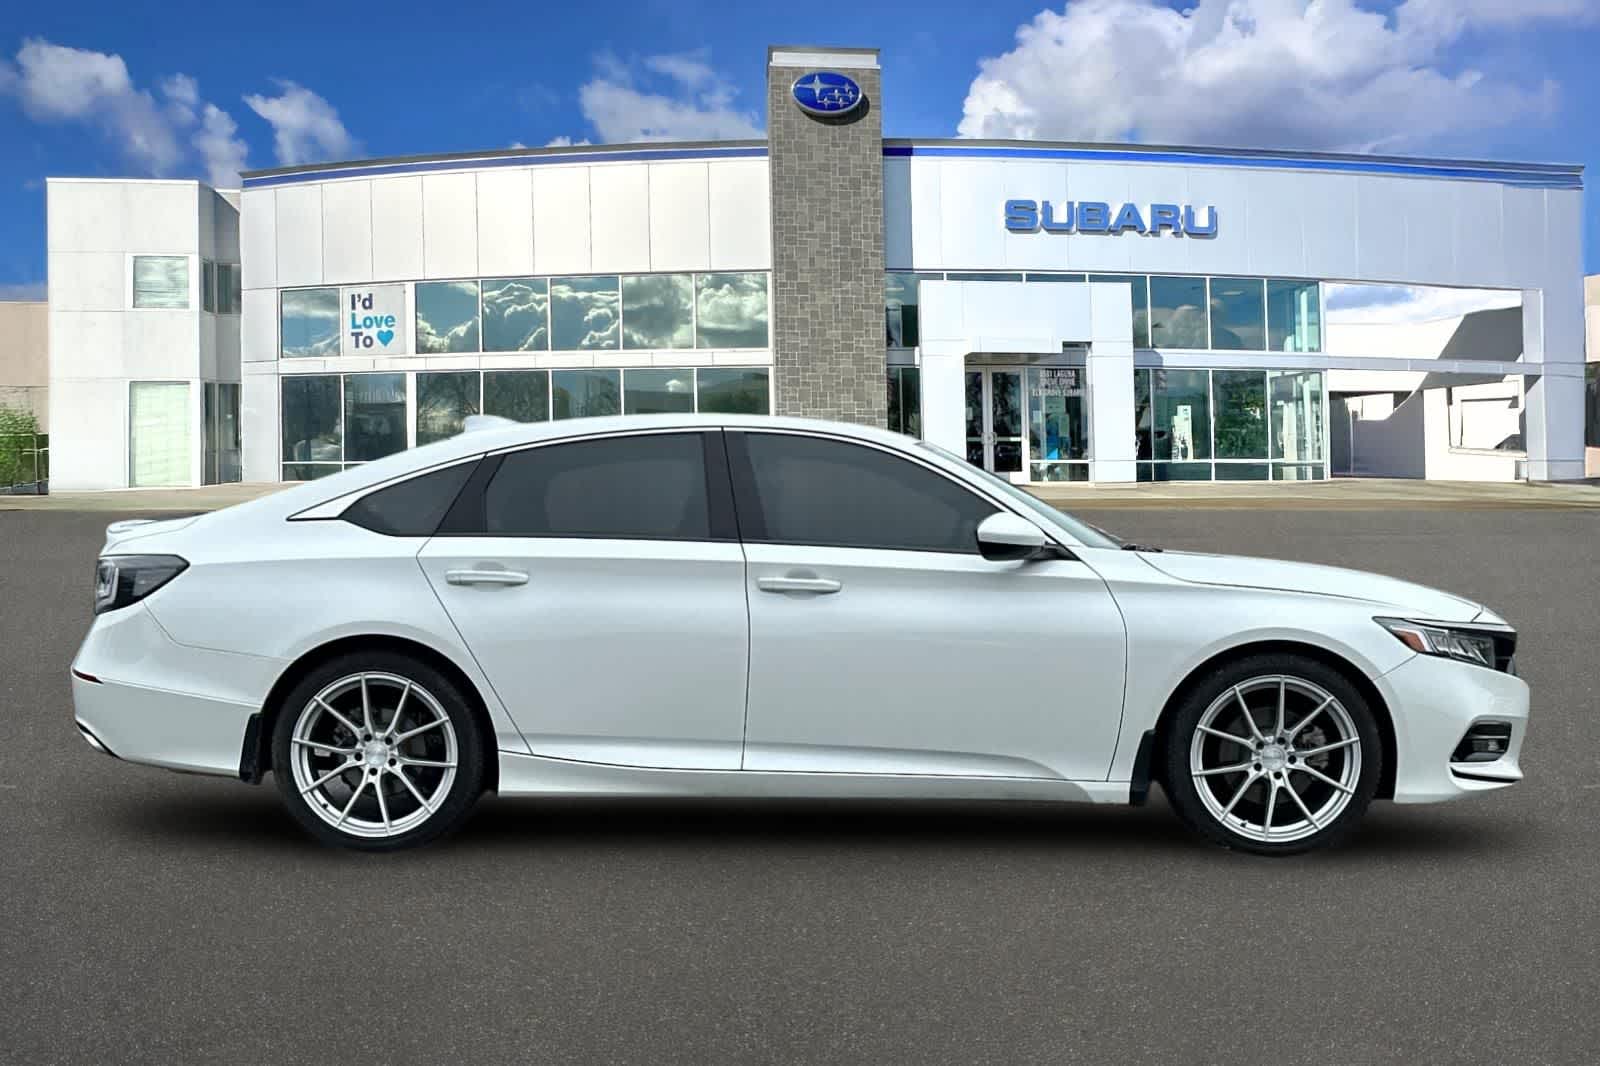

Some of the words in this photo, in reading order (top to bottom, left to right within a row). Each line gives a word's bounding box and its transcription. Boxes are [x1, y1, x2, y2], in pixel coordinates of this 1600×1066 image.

[1005, 199, 1218, 238] SUBARU
[351, 293, 373, 310] I'd
[351, 312, 396, 329] Love
[351, 331, 374, 348] To
